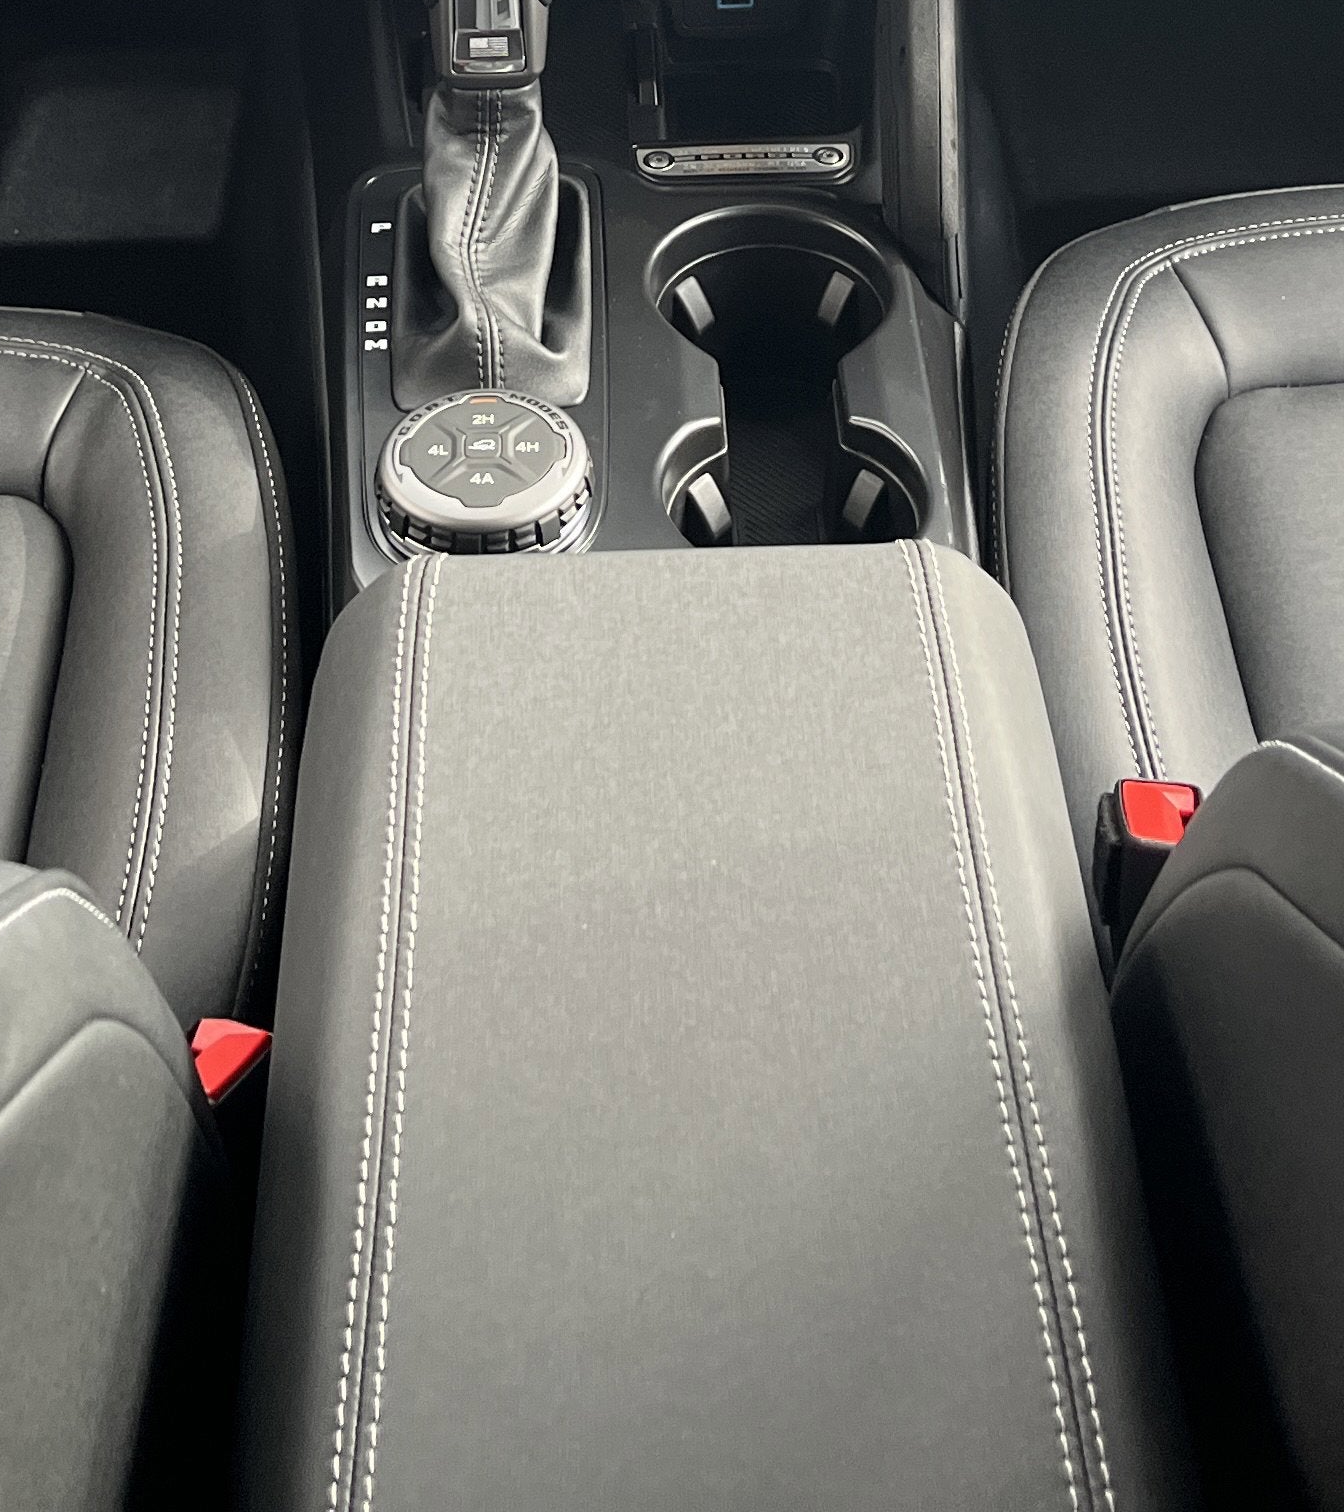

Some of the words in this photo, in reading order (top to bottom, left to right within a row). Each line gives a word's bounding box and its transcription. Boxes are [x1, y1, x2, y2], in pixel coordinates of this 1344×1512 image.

[509, 392, 569, 431] MODES
[471, 413, 495, 425] 2H
[427, 444, 449, 456] 4L
[515, 441, 540, 453] 4H
[469, 471, 495, 485] 4A
